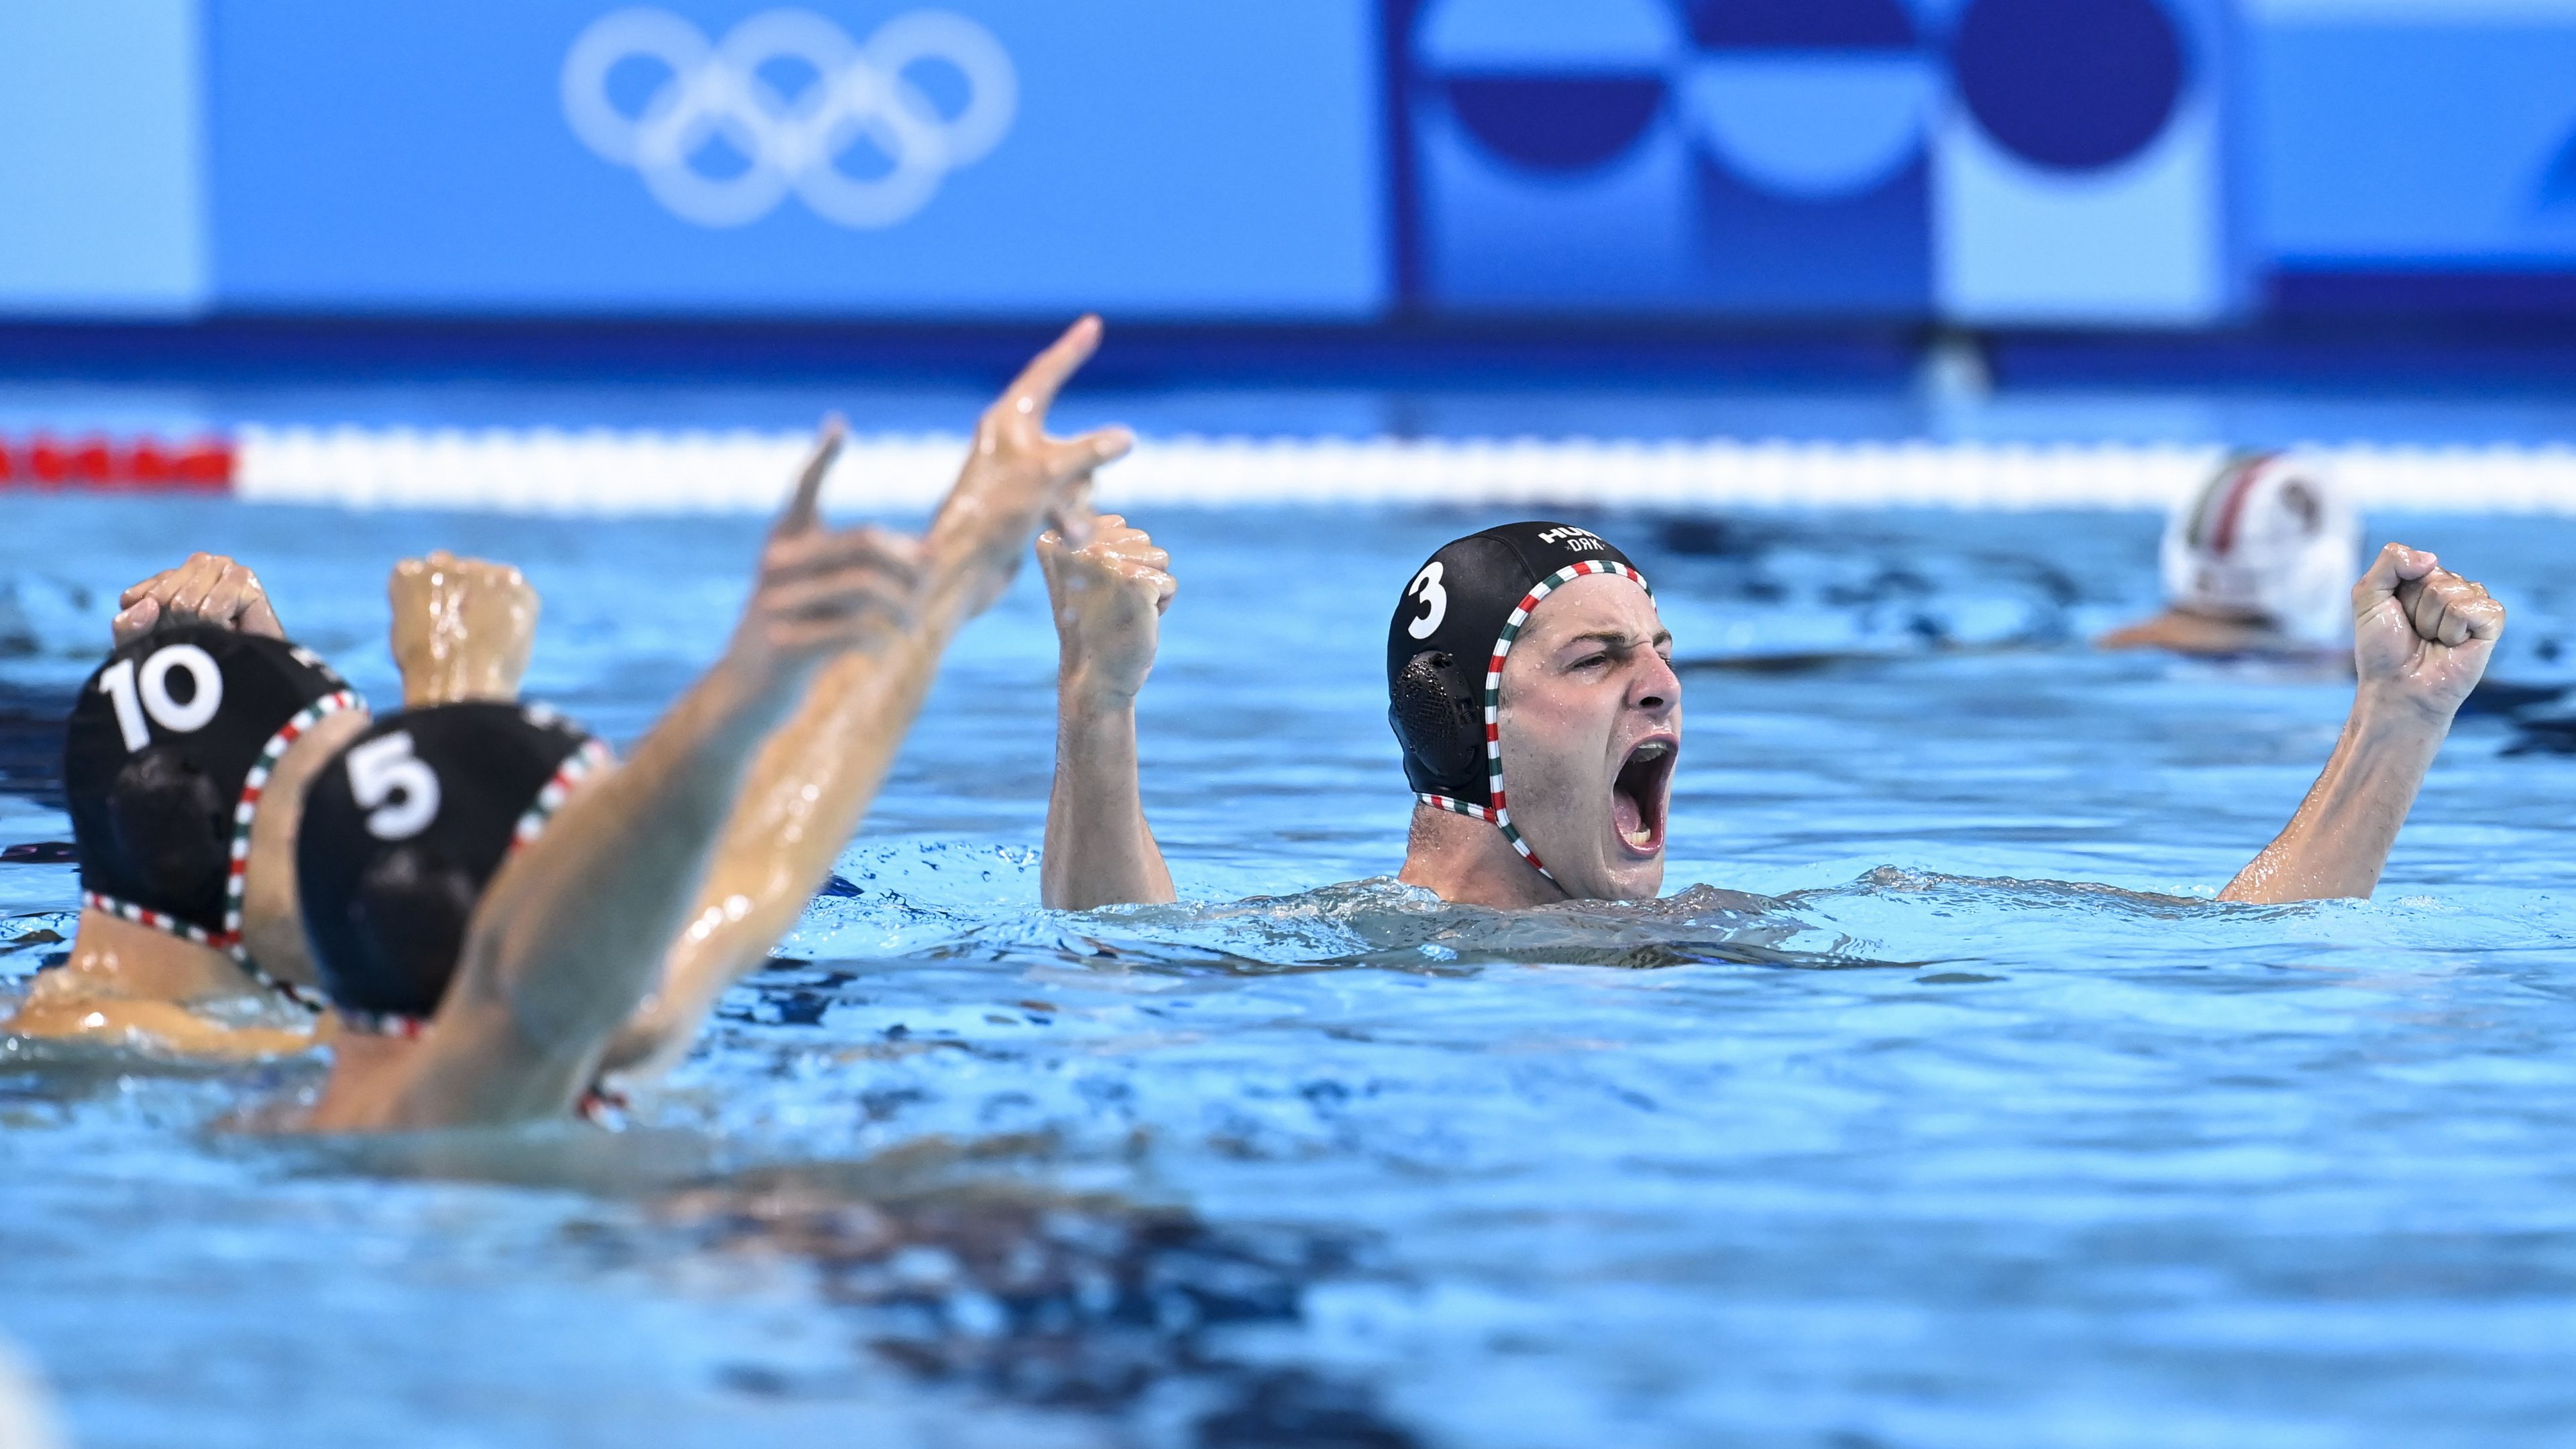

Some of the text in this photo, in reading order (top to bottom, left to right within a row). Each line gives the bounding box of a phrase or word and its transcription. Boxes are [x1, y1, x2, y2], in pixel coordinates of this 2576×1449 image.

[1408, 561, 1447, 639] 3
[98, 643, 224, 753] 10
[345, 731, 441, 840] 5
